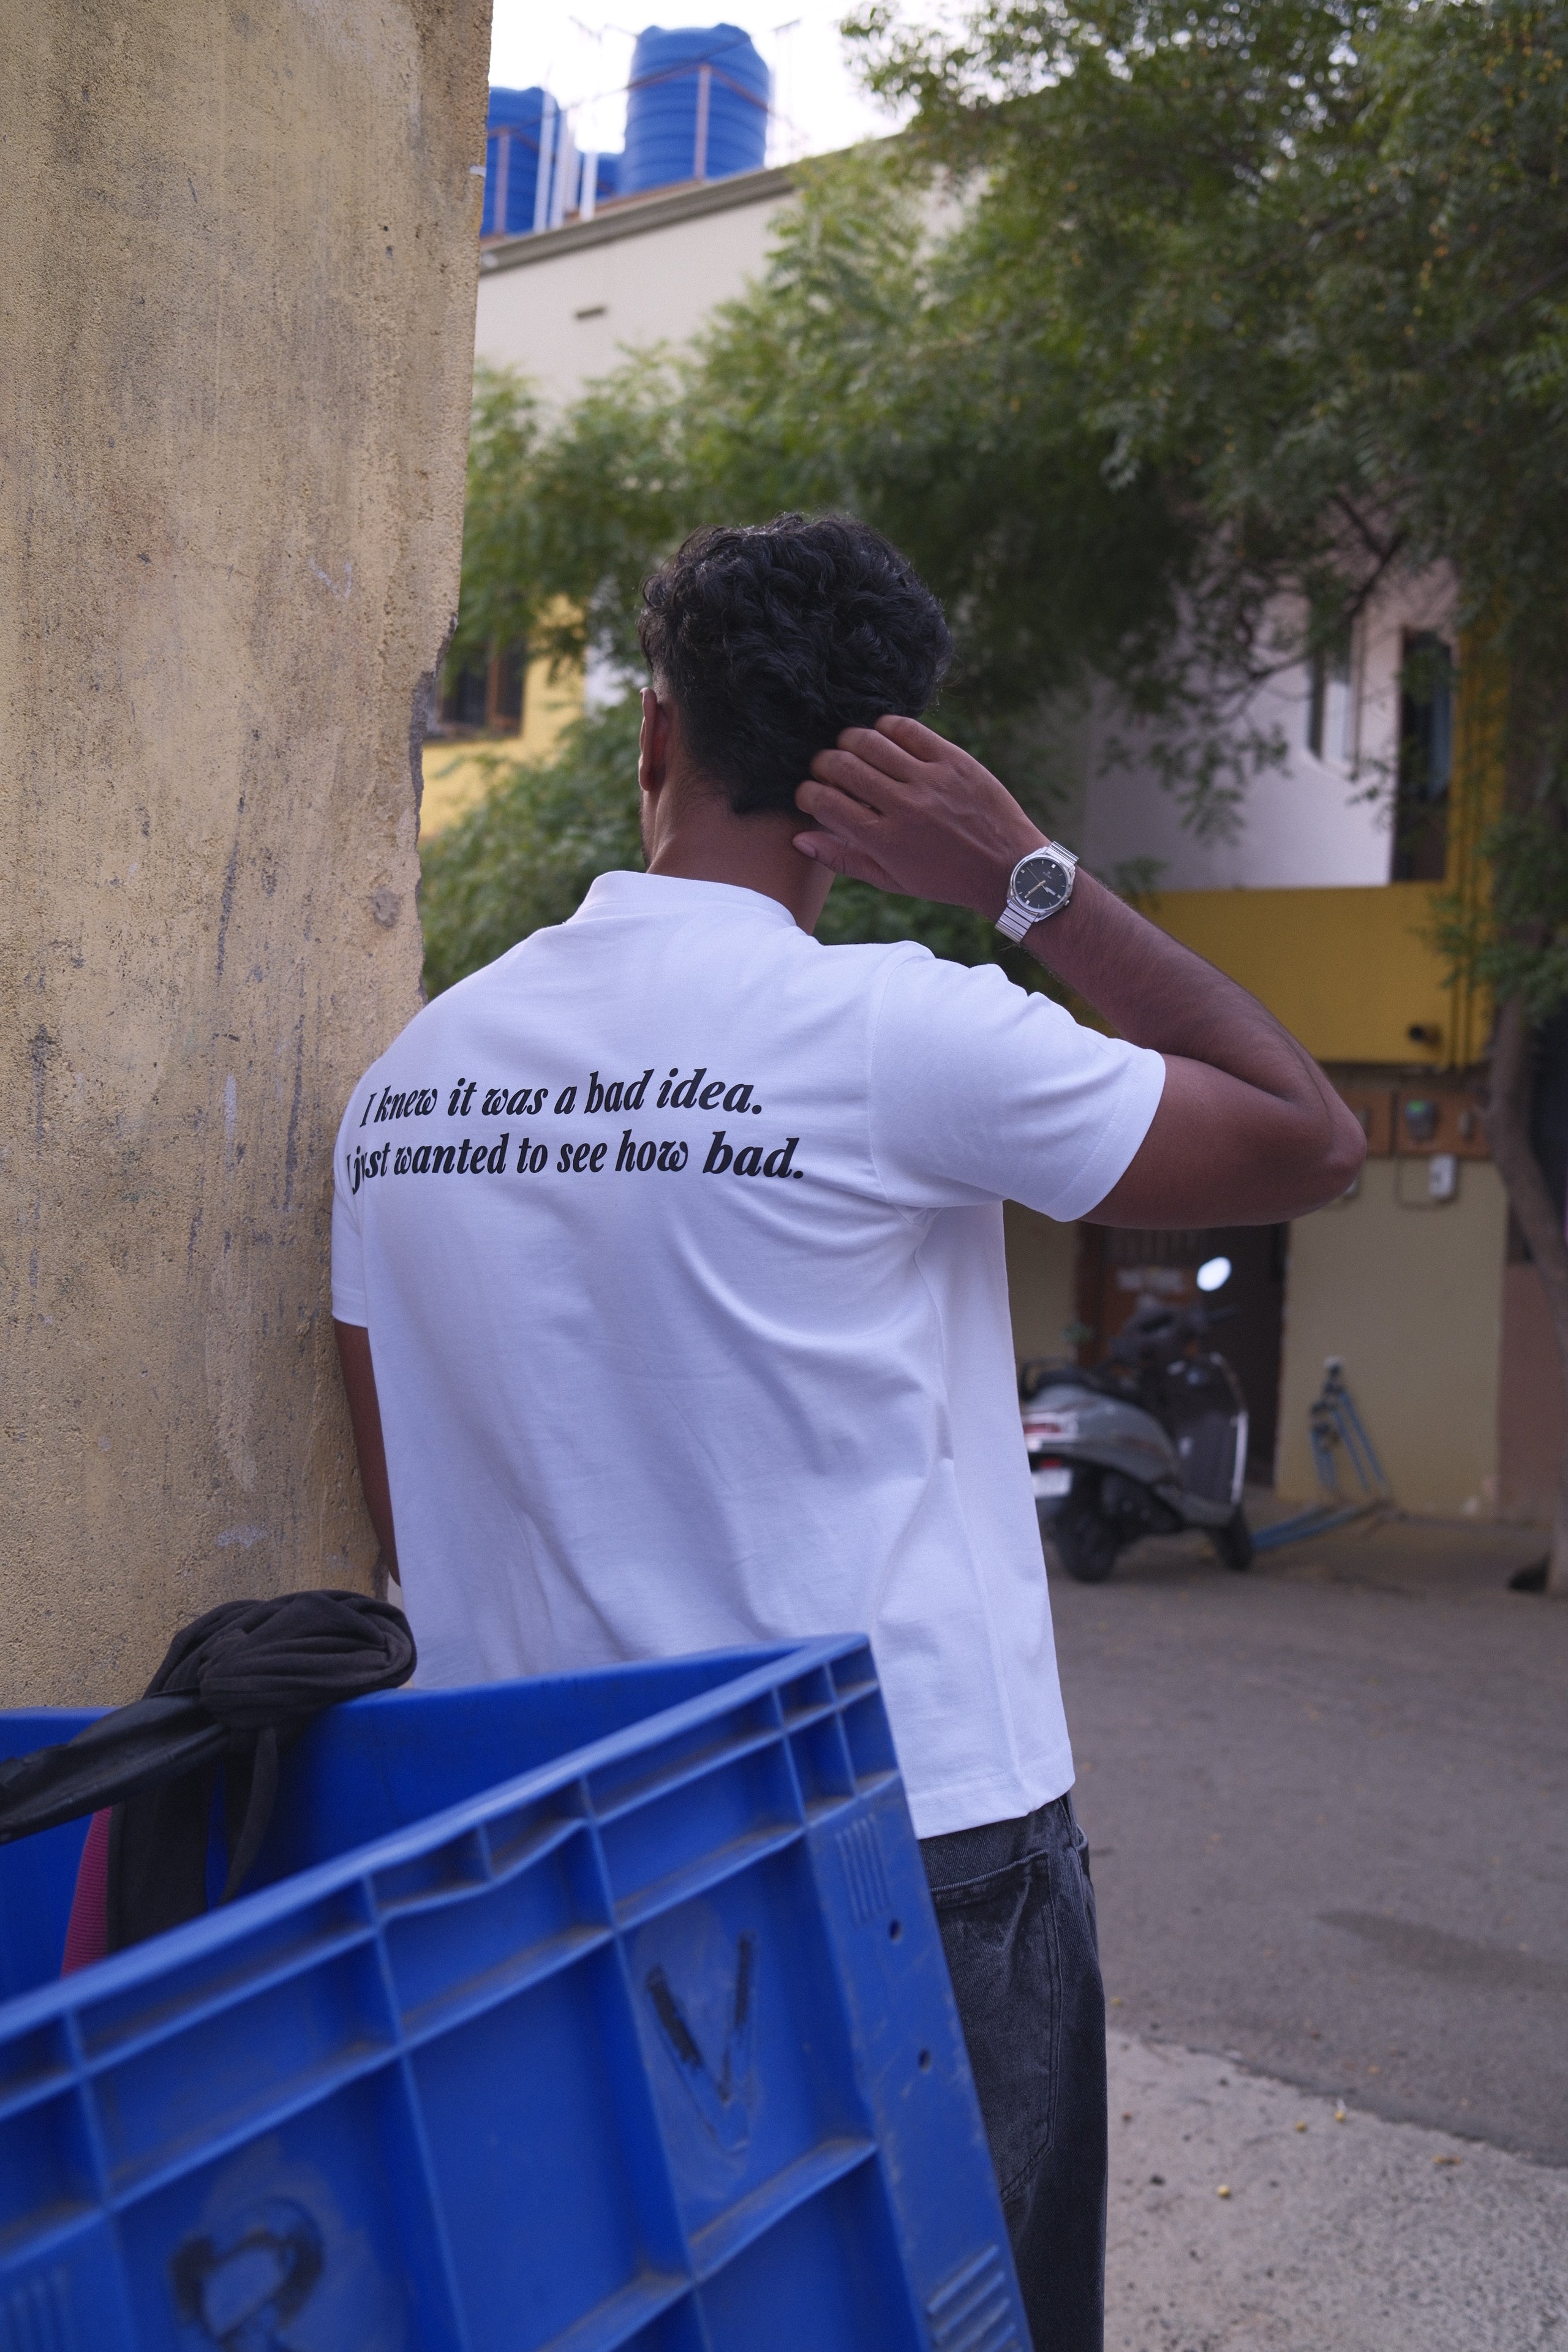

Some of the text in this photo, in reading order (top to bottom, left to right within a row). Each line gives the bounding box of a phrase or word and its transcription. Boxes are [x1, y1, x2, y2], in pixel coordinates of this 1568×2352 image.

[359, 1068, 763, 1128] I knew it was a bad idea.
[393, 1133, 510, 1175] wanted
[516, 1137, 548, 1174] to
[556, 1142, 608, 1173] see
[614, 1128, 688, 1172] how
[702, 1130, 804, 1180] bad.
